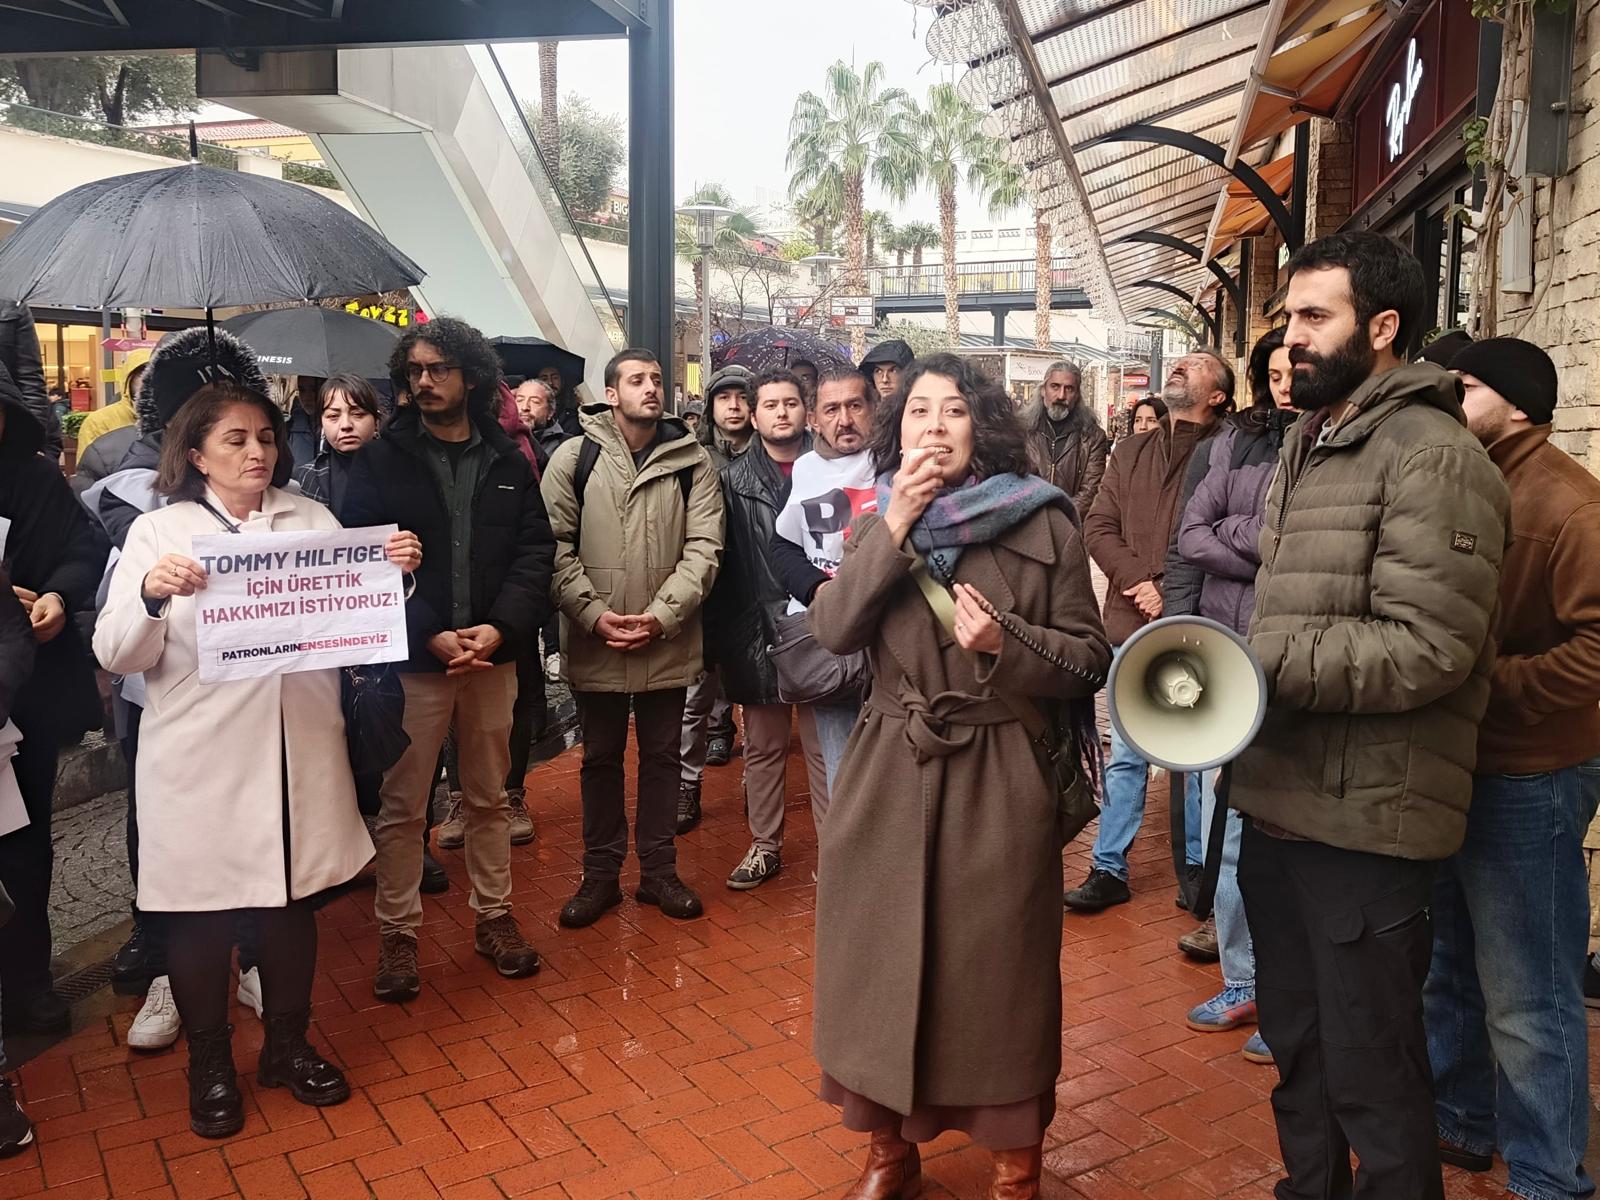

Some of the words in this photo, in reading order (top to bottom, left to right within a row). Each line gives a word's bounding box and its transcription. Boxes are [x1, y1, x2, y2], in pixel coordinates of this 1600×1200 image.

[257, 355, 293, 365] INESIS
[200, 552, 289, 576] TOMMY
[247, 576, 283, 599] İÇİN
[288, 569, 363, 592] ÜRETTİK
[203, 601, 295, 624] HAKKIMIZI
[300, 592, 398, 614] İSTİYORUZ!
